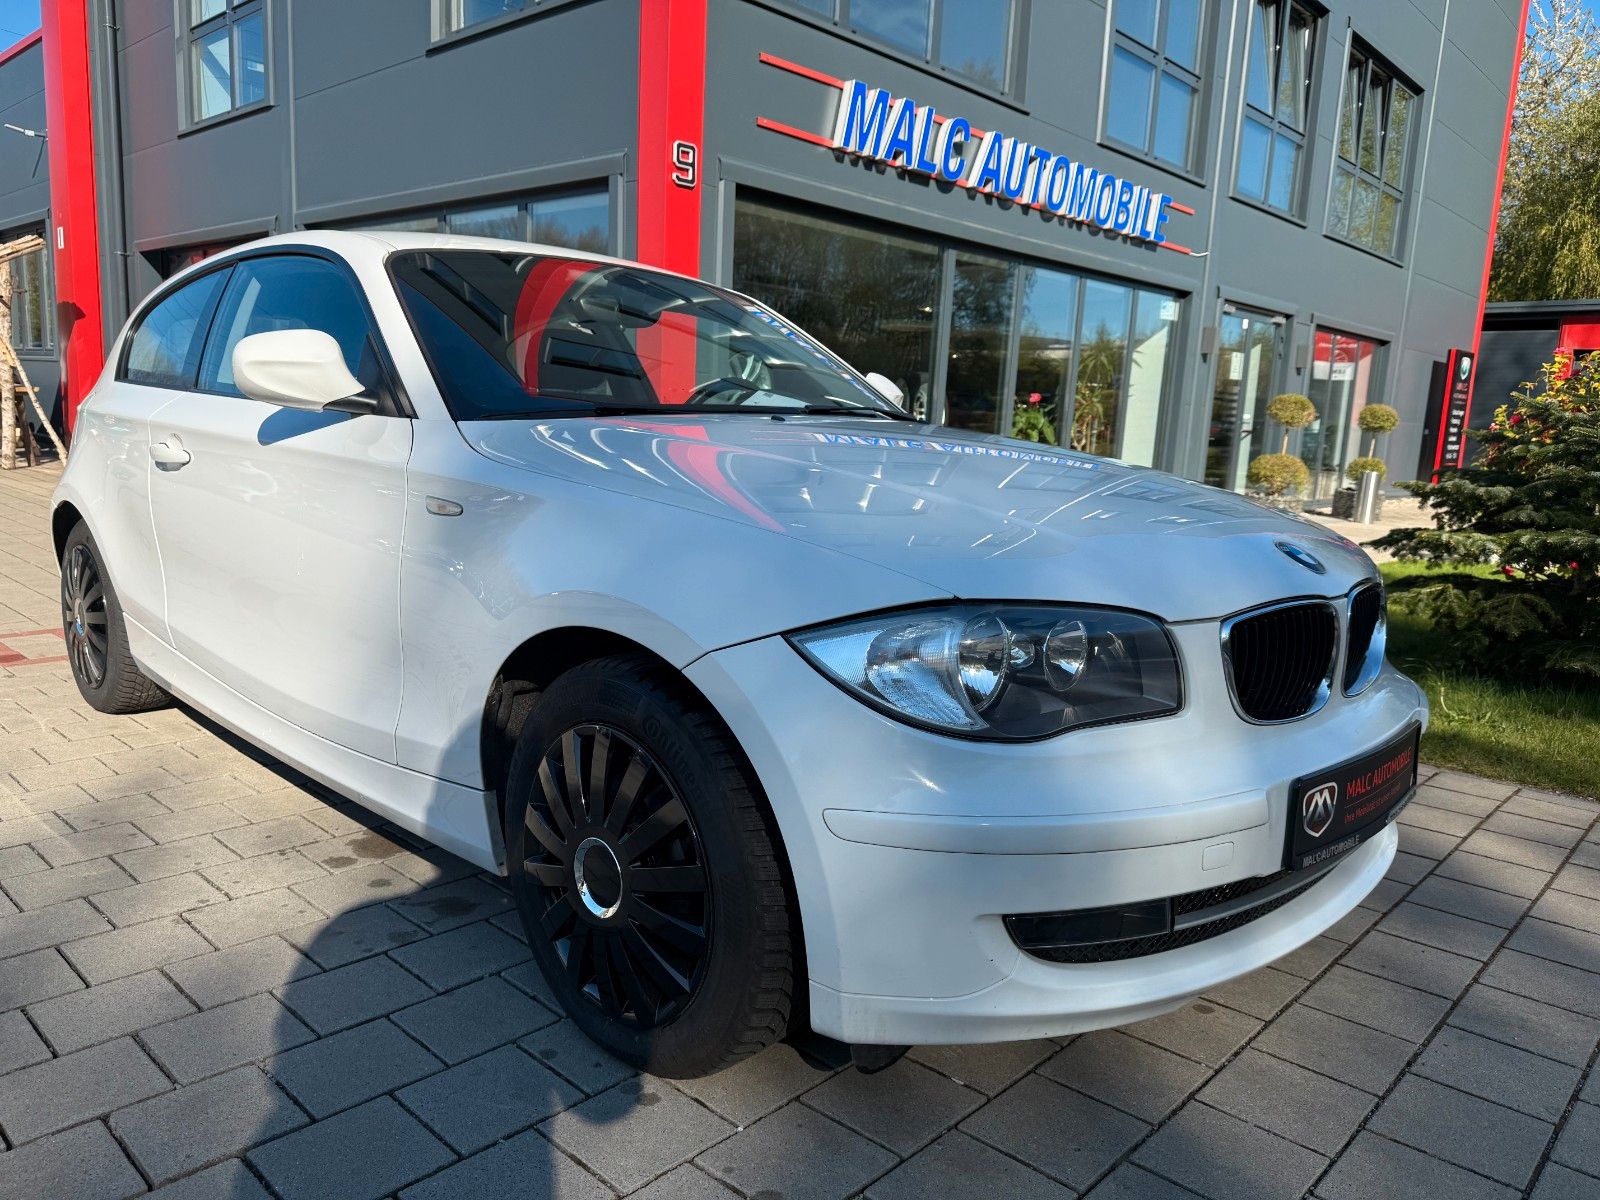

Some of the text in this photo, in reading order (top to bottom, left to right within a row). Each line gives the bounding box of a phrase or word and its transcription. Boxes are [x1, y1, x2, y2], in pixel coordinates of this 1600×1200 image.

[672, 140, 697, 187] 9
[835, 79, 1173, 243] MALC AUTOMOBILE
[1346, 772, 1371, 800] MALC
[1372, 747, 1413, 786] AUTOMOBILE
